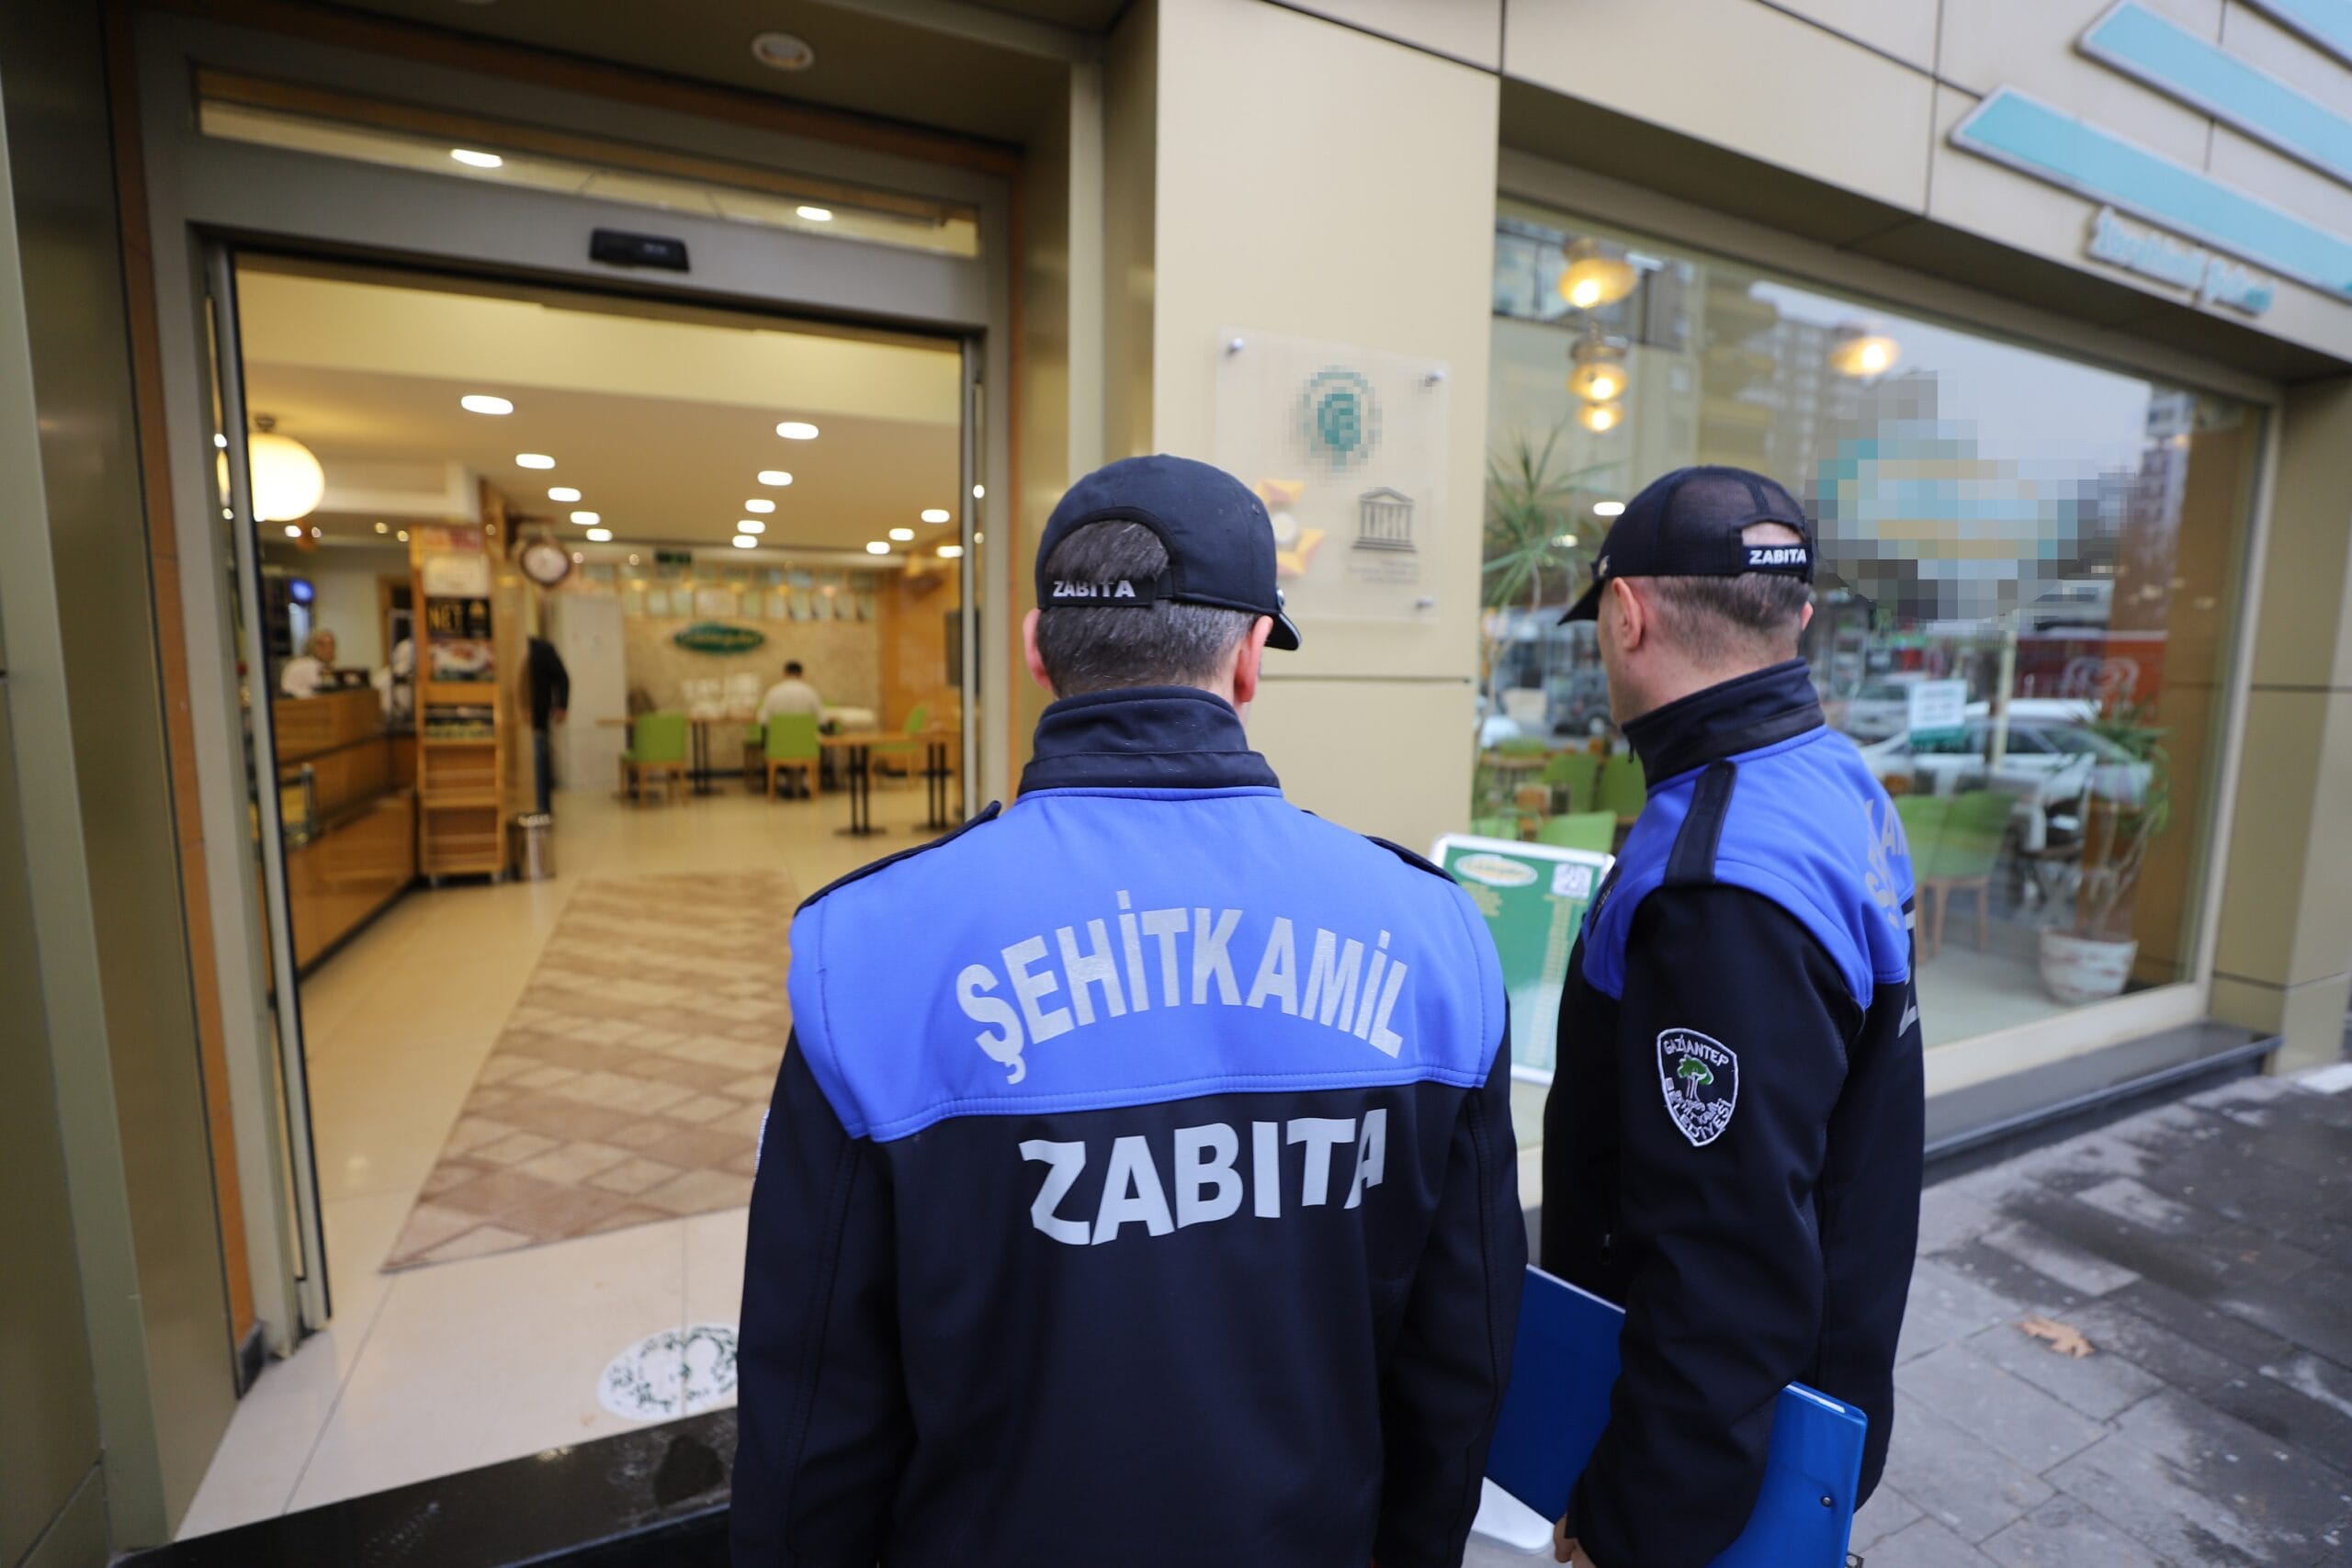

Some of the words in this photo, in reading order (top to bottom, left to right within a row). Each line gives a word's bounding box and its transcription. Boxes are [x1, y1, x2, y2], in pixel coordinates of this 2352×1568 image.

[1749, 548, 1807, 565] ZABITA
[1052, 580, 1136, 598] ZABITA
[956, 889, 1408, 1085] ŞEHİTKAMİL
[1663, 1034, 1729, 1066] GAZİANTEP
[1019, 1108, 1387, 1246] ZABITA
